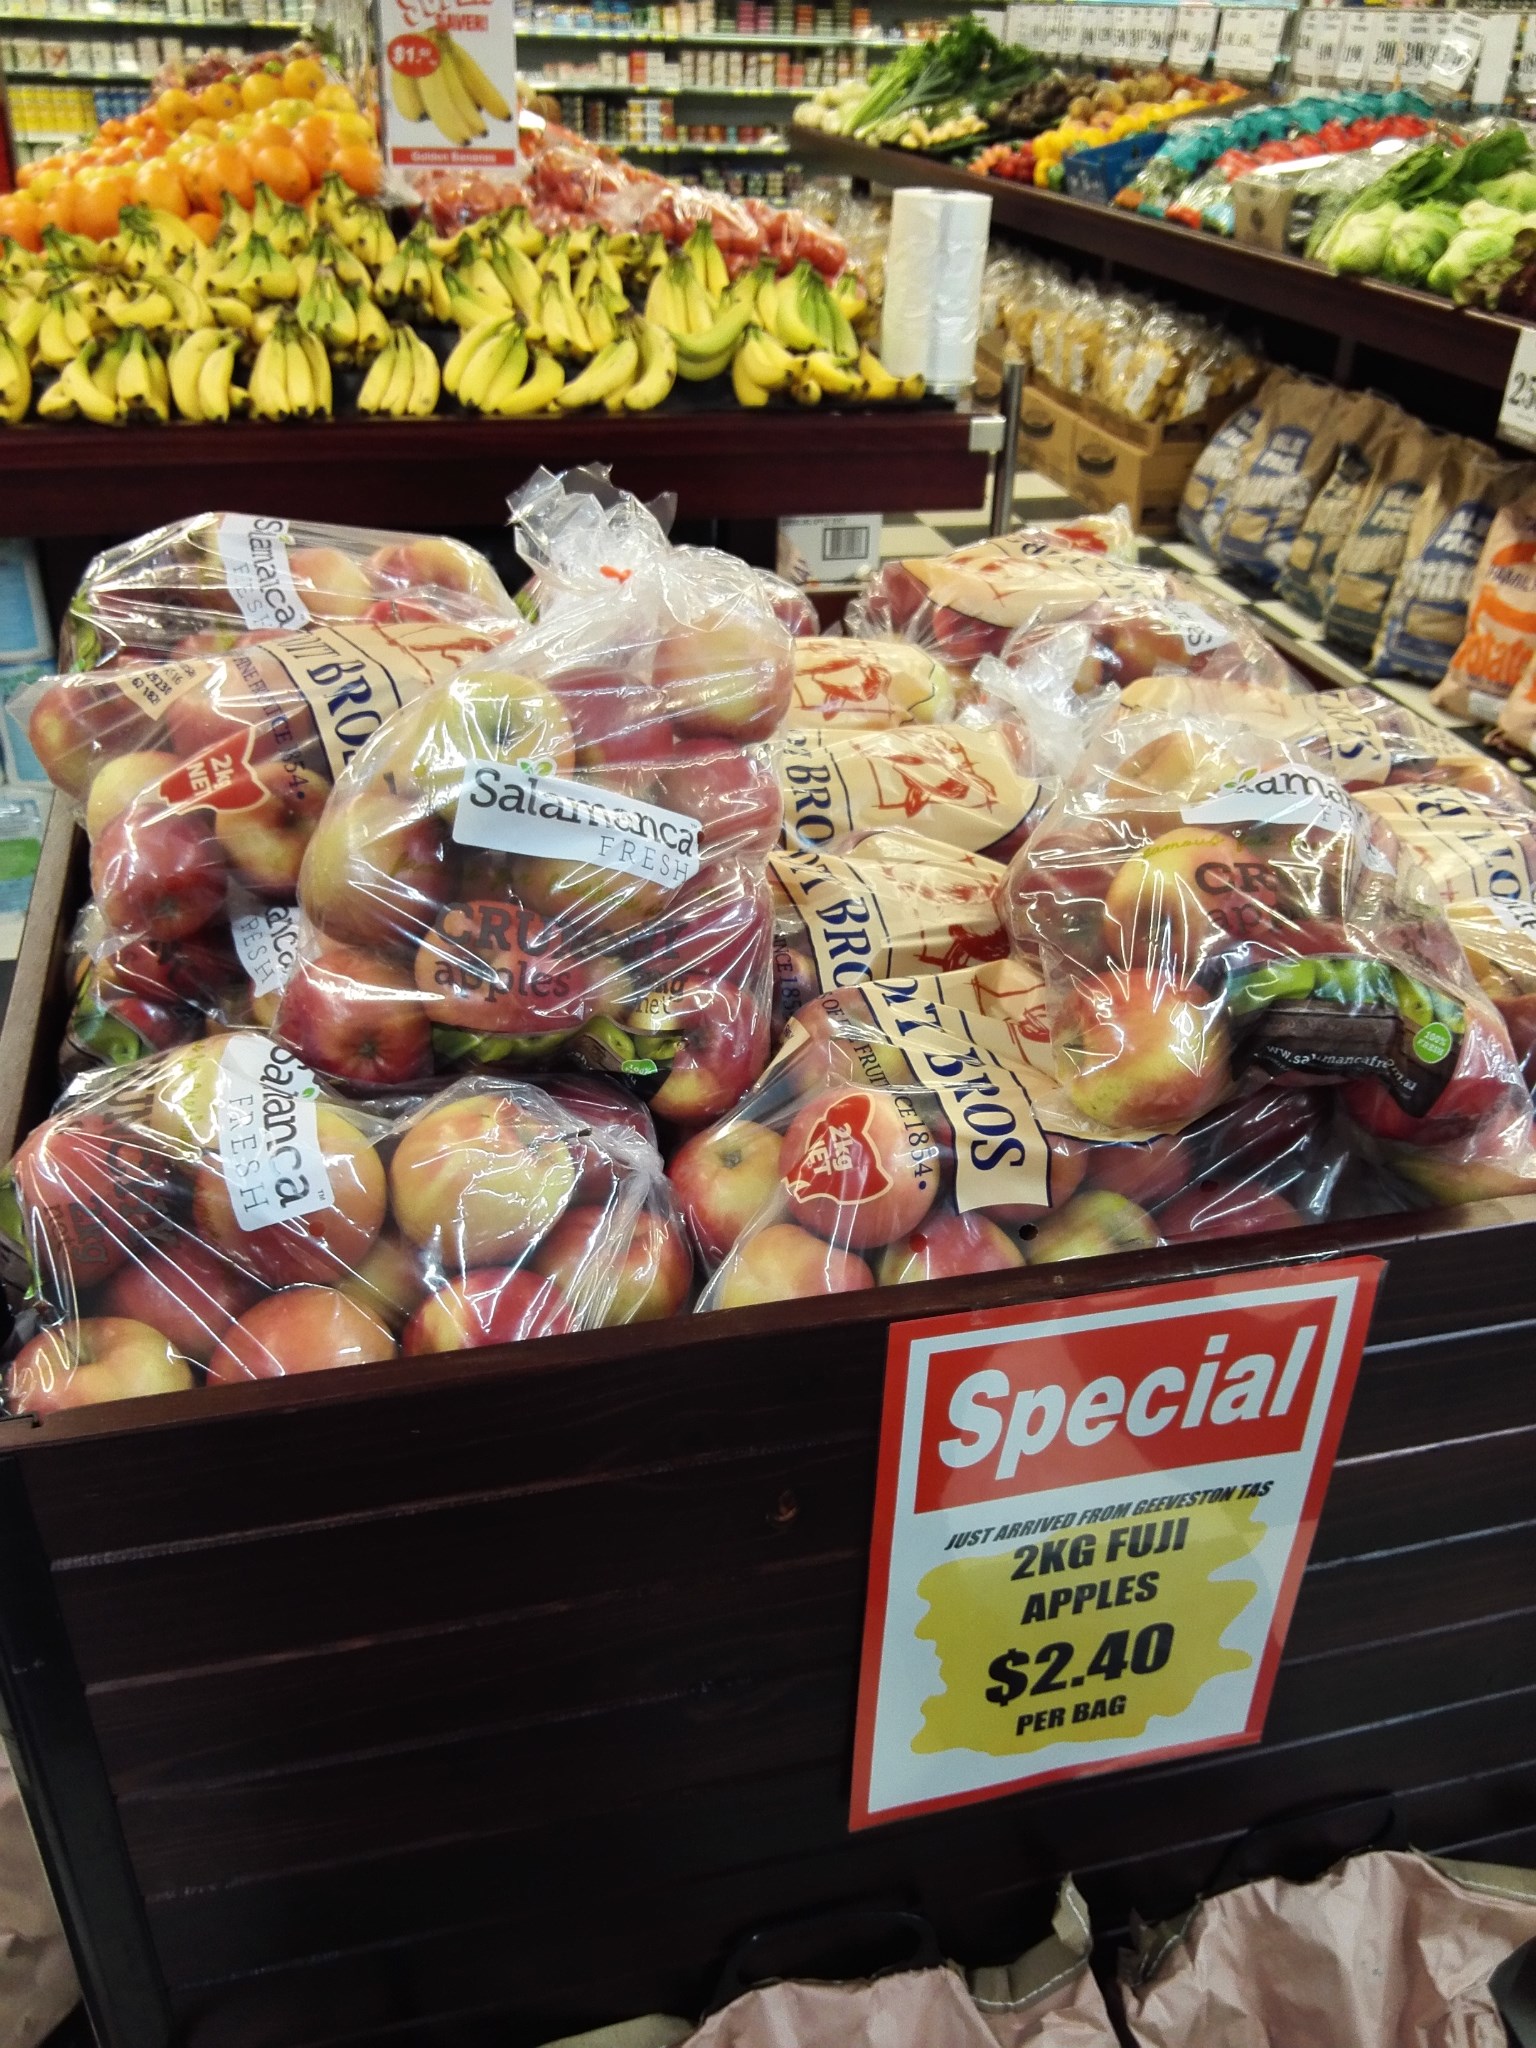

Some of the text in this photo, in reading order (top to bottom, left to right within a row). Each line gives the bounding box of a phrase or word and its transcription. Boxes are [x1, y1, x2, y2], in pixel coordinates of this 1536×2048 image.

[470, 766, 694, 858] Salamanca
[598, 835, 690, 884] FRESH
[433, 959, 572, 1003] apples
[923, 1046, 1027, 1173] BROS
[828, 1122, 853, 1171] 2kg
[938, 1324, 1319, 1481] Special
[944, 1480, 1275, 1551] JUST ARRIVED FROM GEEVESTON TAS
[1010, 1516, 1190, 1581] 2KG FUJI
[1020, 1571, 1161, 1626] APPLES
[985, 1622, 1175, 1707] $2.40
[1015, 1694, 1127, 1737] PER BAG
